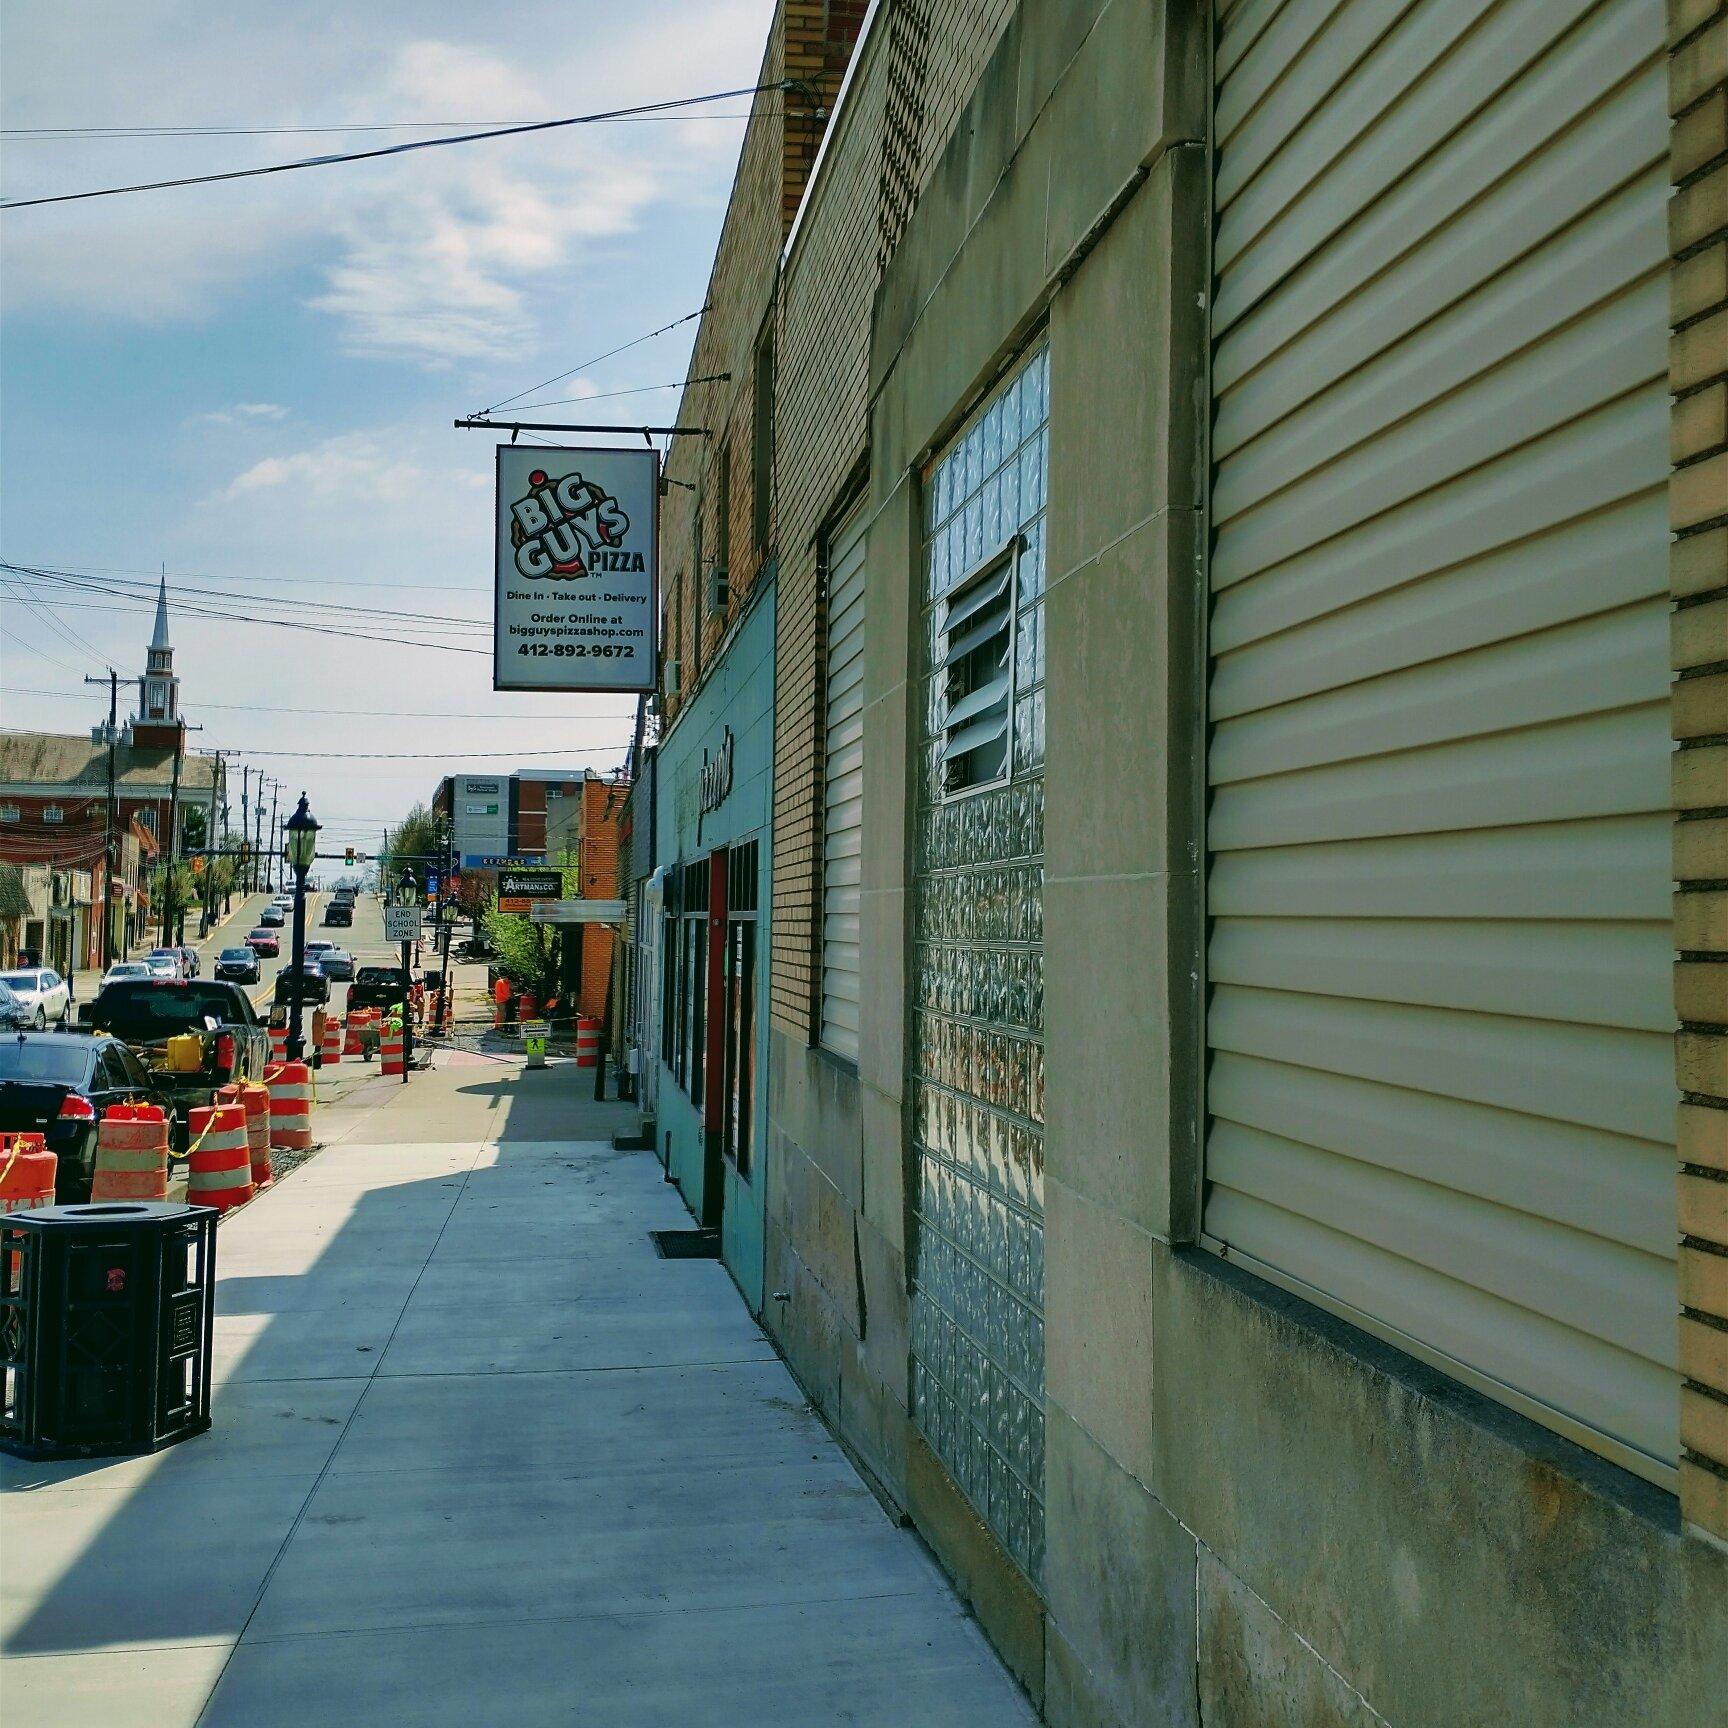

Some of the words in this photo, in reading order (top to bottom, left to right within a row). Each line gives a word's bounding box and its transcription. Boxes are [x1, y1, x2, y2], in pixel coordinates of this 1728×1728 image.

[515, 497, 630, 578] GUYS
[587, 551, 645, 572] PIZZA
[507, 591, 531, 600] Dine
[534, 592, 544, 600] In
[552, 592, 577, 601] Take
[604, 593, 647, 604] Delivery
[531, 613, 565, 623] Order
[568, 614, 608, 624] Online
[611, 616, 623, 624] at
[509, 625, 644, 638] bigguyspizzashop.com
[517, 643, 635, 658] 412-892-9672
[395, 910, 411, 918] END
[387, 920, 419, 928] SCHOOL
[393, 929, 414, 937] ZONE
